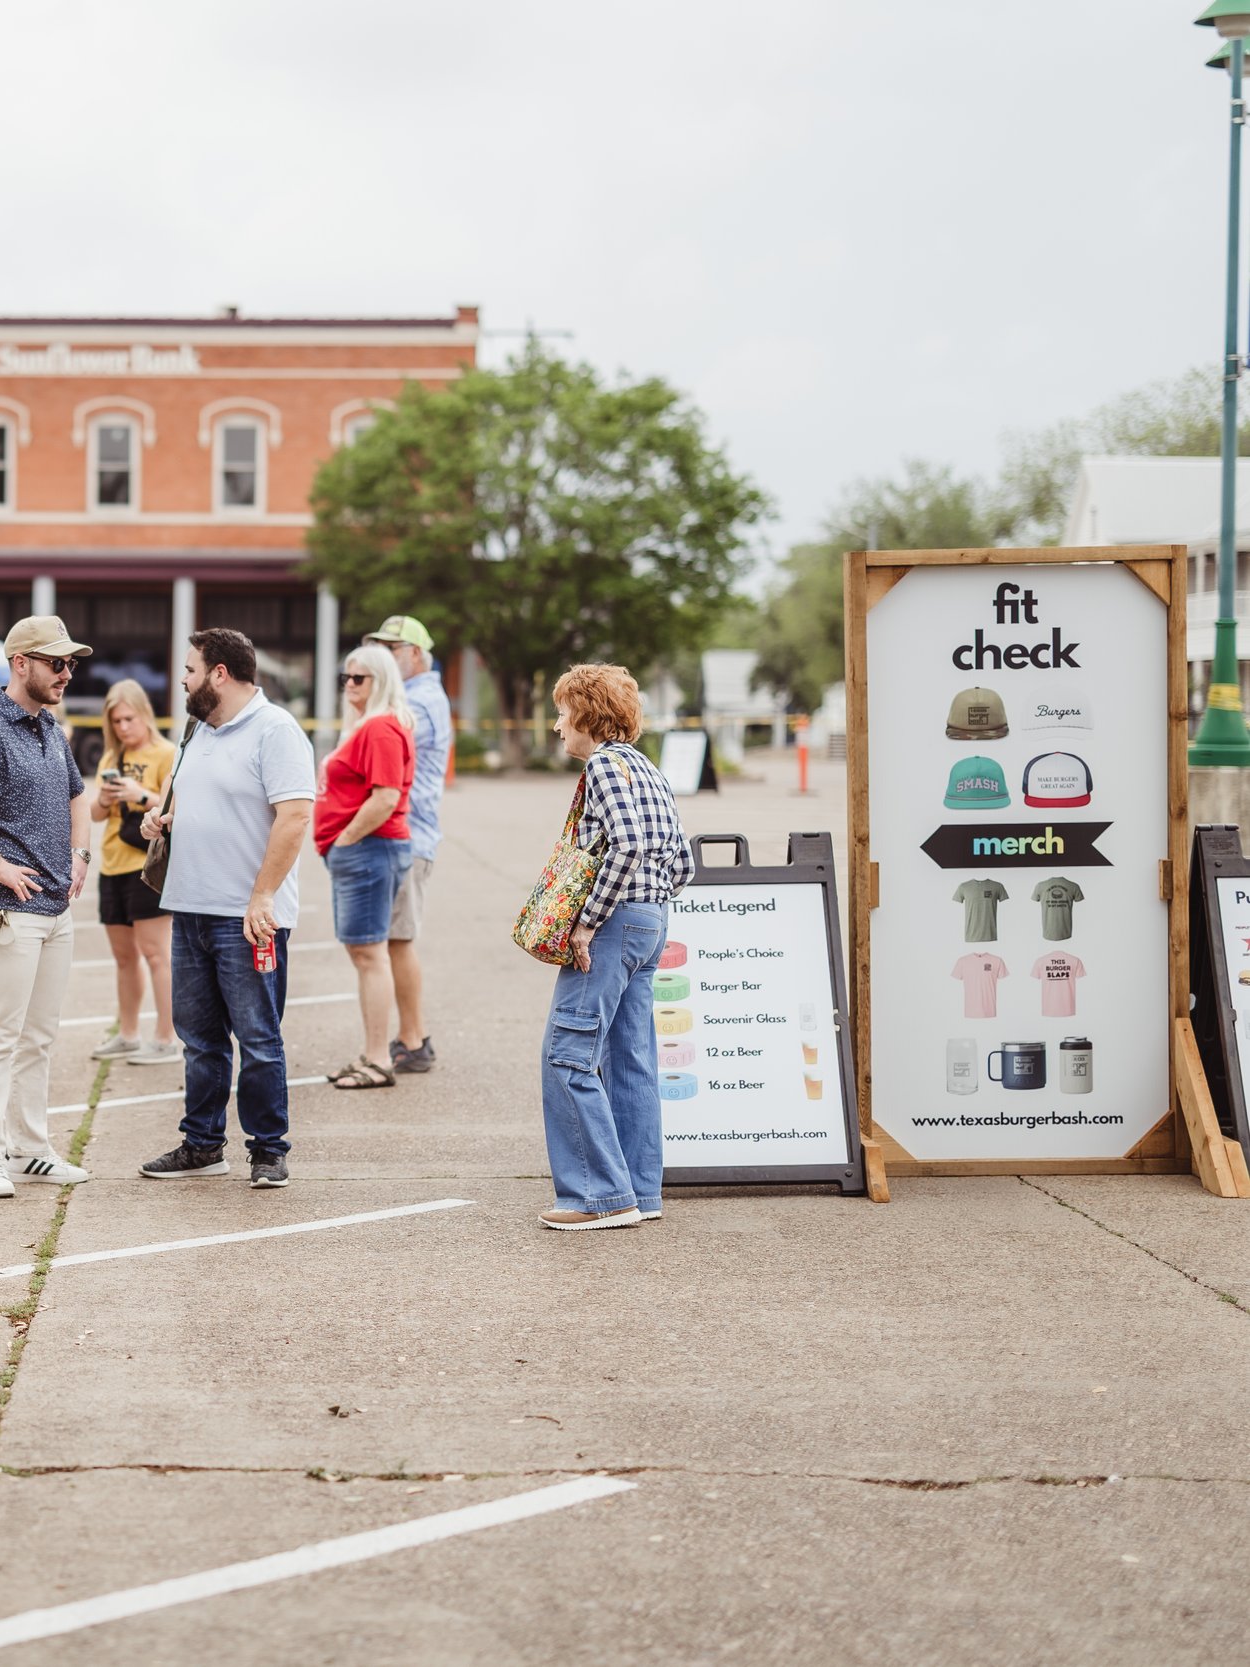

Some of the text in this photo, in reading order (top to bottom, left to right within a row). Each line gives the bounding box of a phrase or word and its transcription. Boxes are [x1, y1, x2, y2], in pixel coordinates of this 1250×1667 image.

[993, 582, 1039, 624] fit
[952, 627, 1082, 671] check
[1035, 704, 1081, 720] Burgers
[956, 777, 999, 793] SMASH
[973, 827, 1064, 855] merch
[669, 898, 776, 916] Ticket Legend
[698, 948, 784, 960] People's Choice
[700, 981, 762, 993] Burger Bar
[703, 1013, 787, 1025] Souvenir Glass
[706, 1046, 763, 1057] 12 oz Beer
[708, 1079, 765, 1091] 16 oz Beer
[911, 1110, 1124, 1130] www.texasburgerbash.com
[664, 1128, 827, 1144] www.texasburgerbash.com
